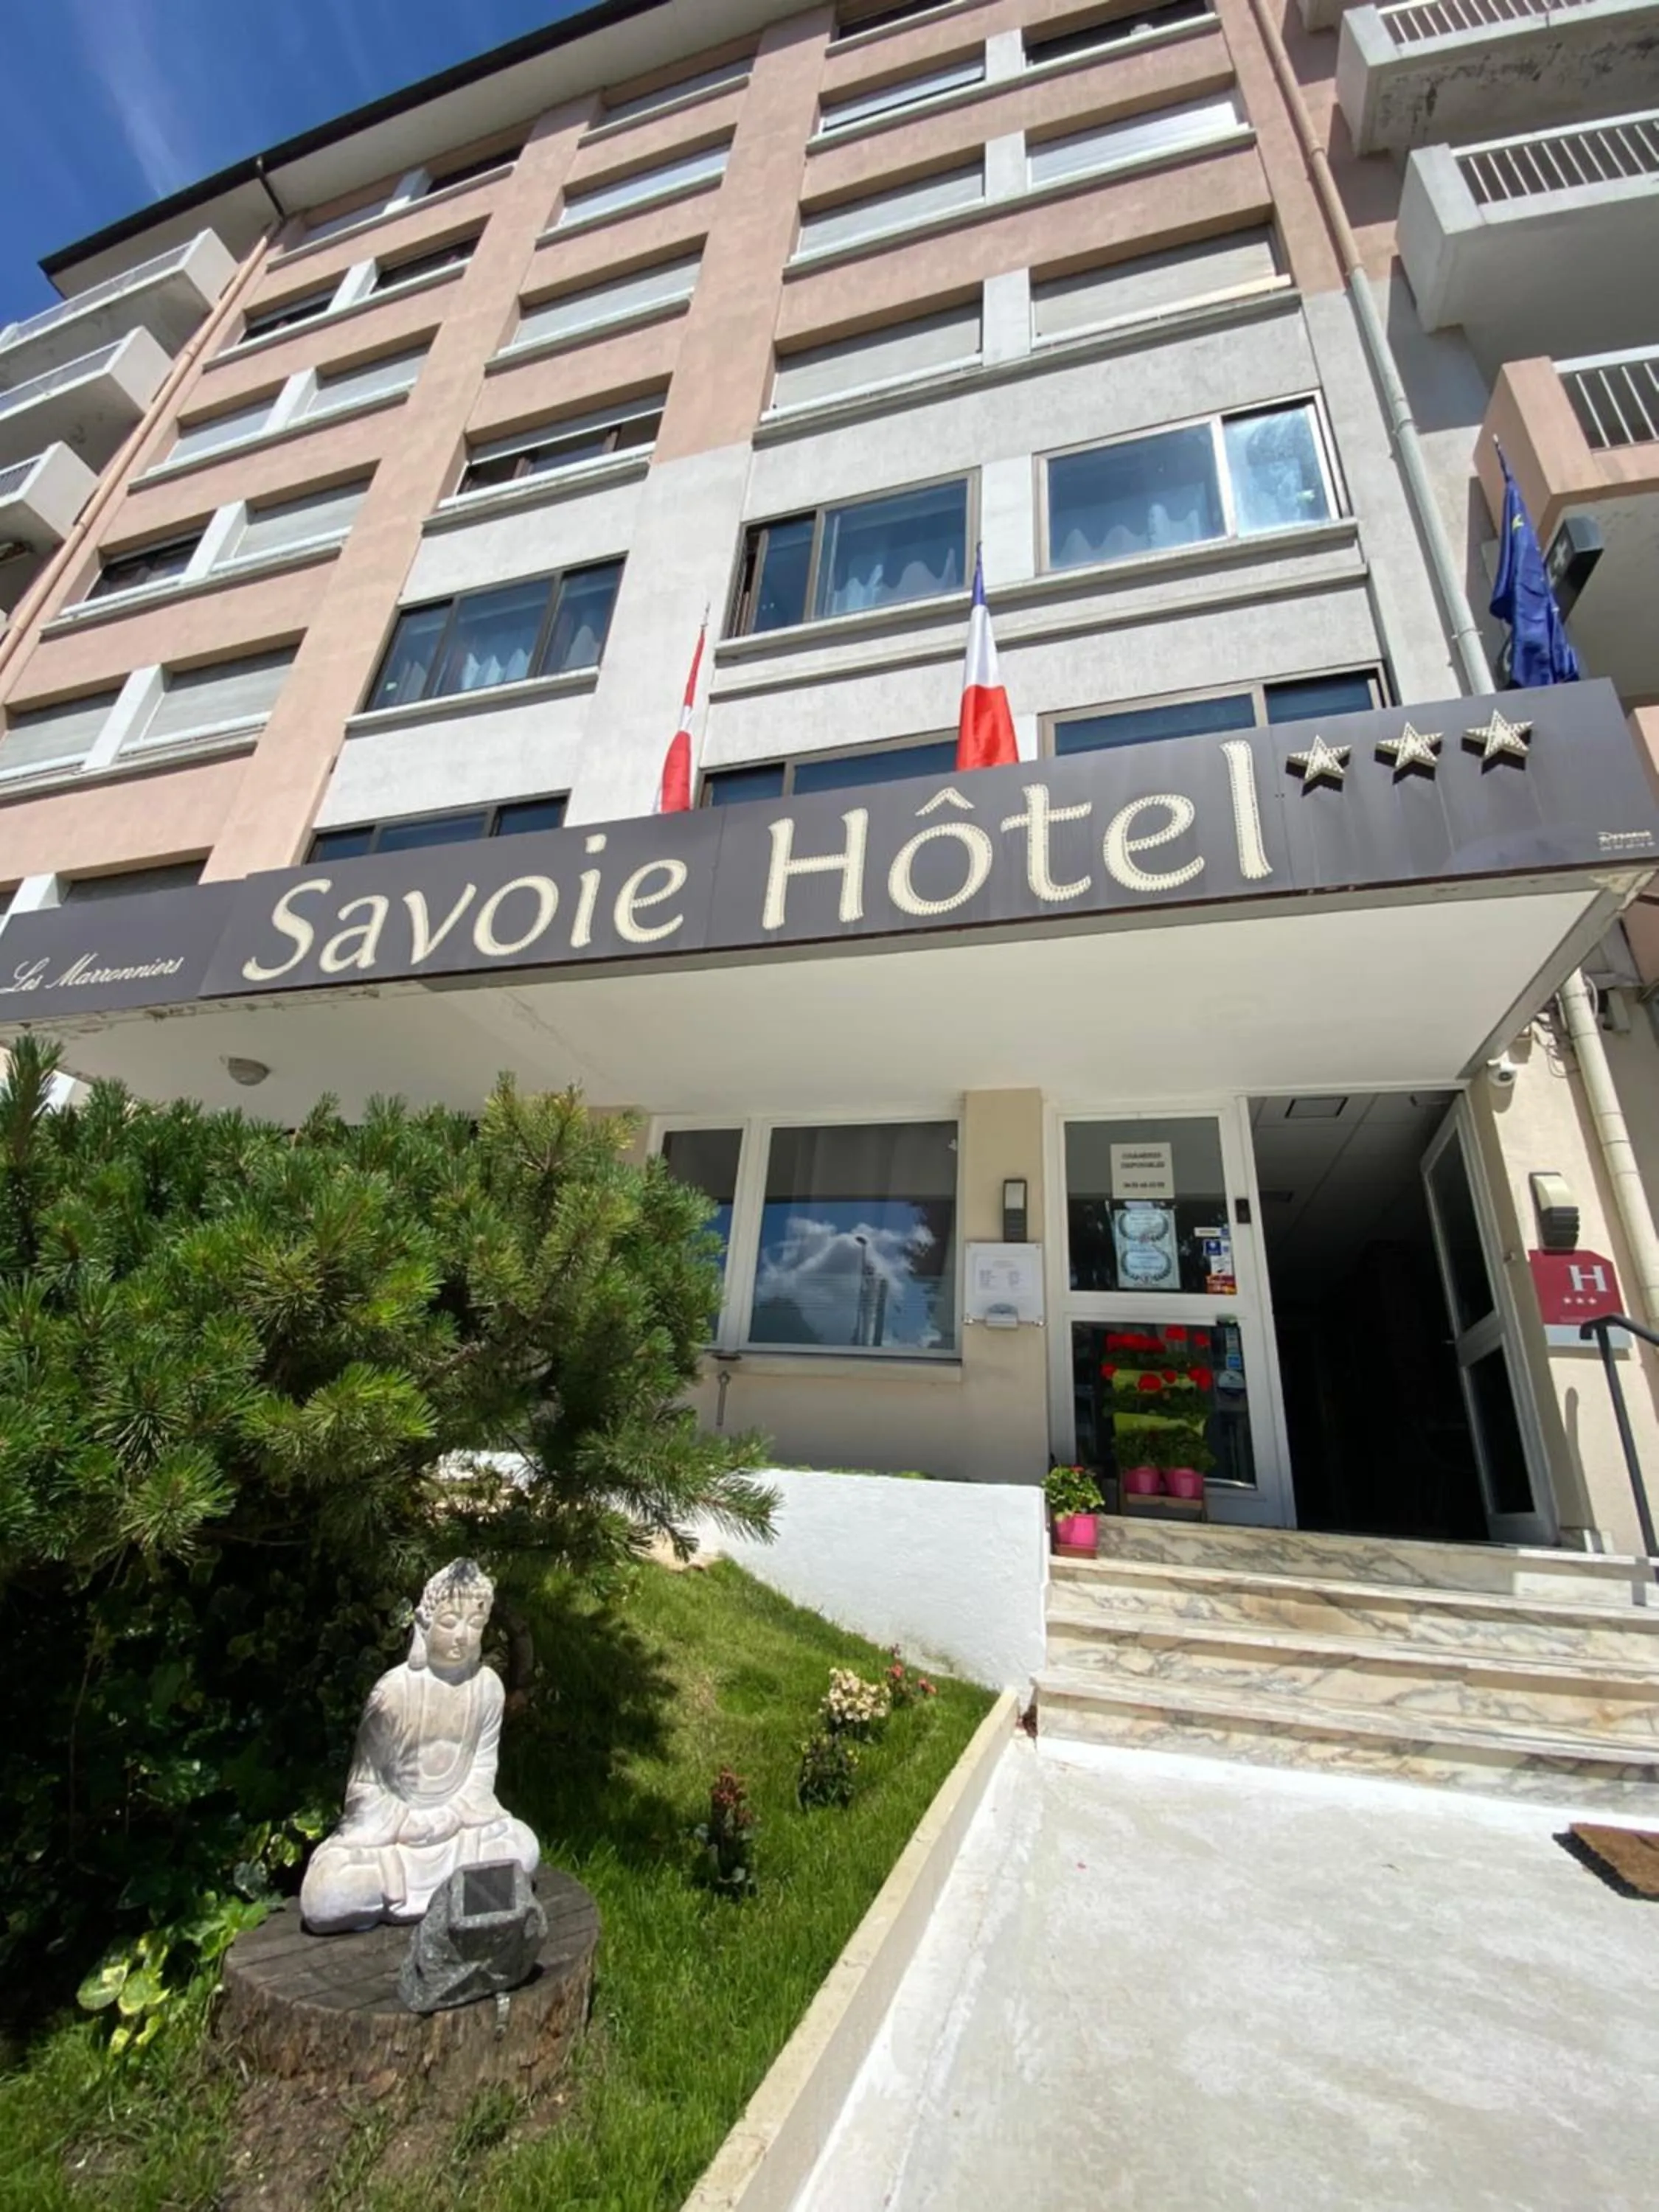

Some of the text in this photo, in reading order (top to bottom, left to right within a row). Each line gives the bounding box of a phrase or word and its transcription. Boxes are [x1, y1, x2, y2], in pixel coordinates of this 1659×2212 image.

[242, 739, 1273, 981] Savoie Hôtel
[0, 952, 185, 994] Les Marronniers
[1568, 1265, 1608, 1293] H
